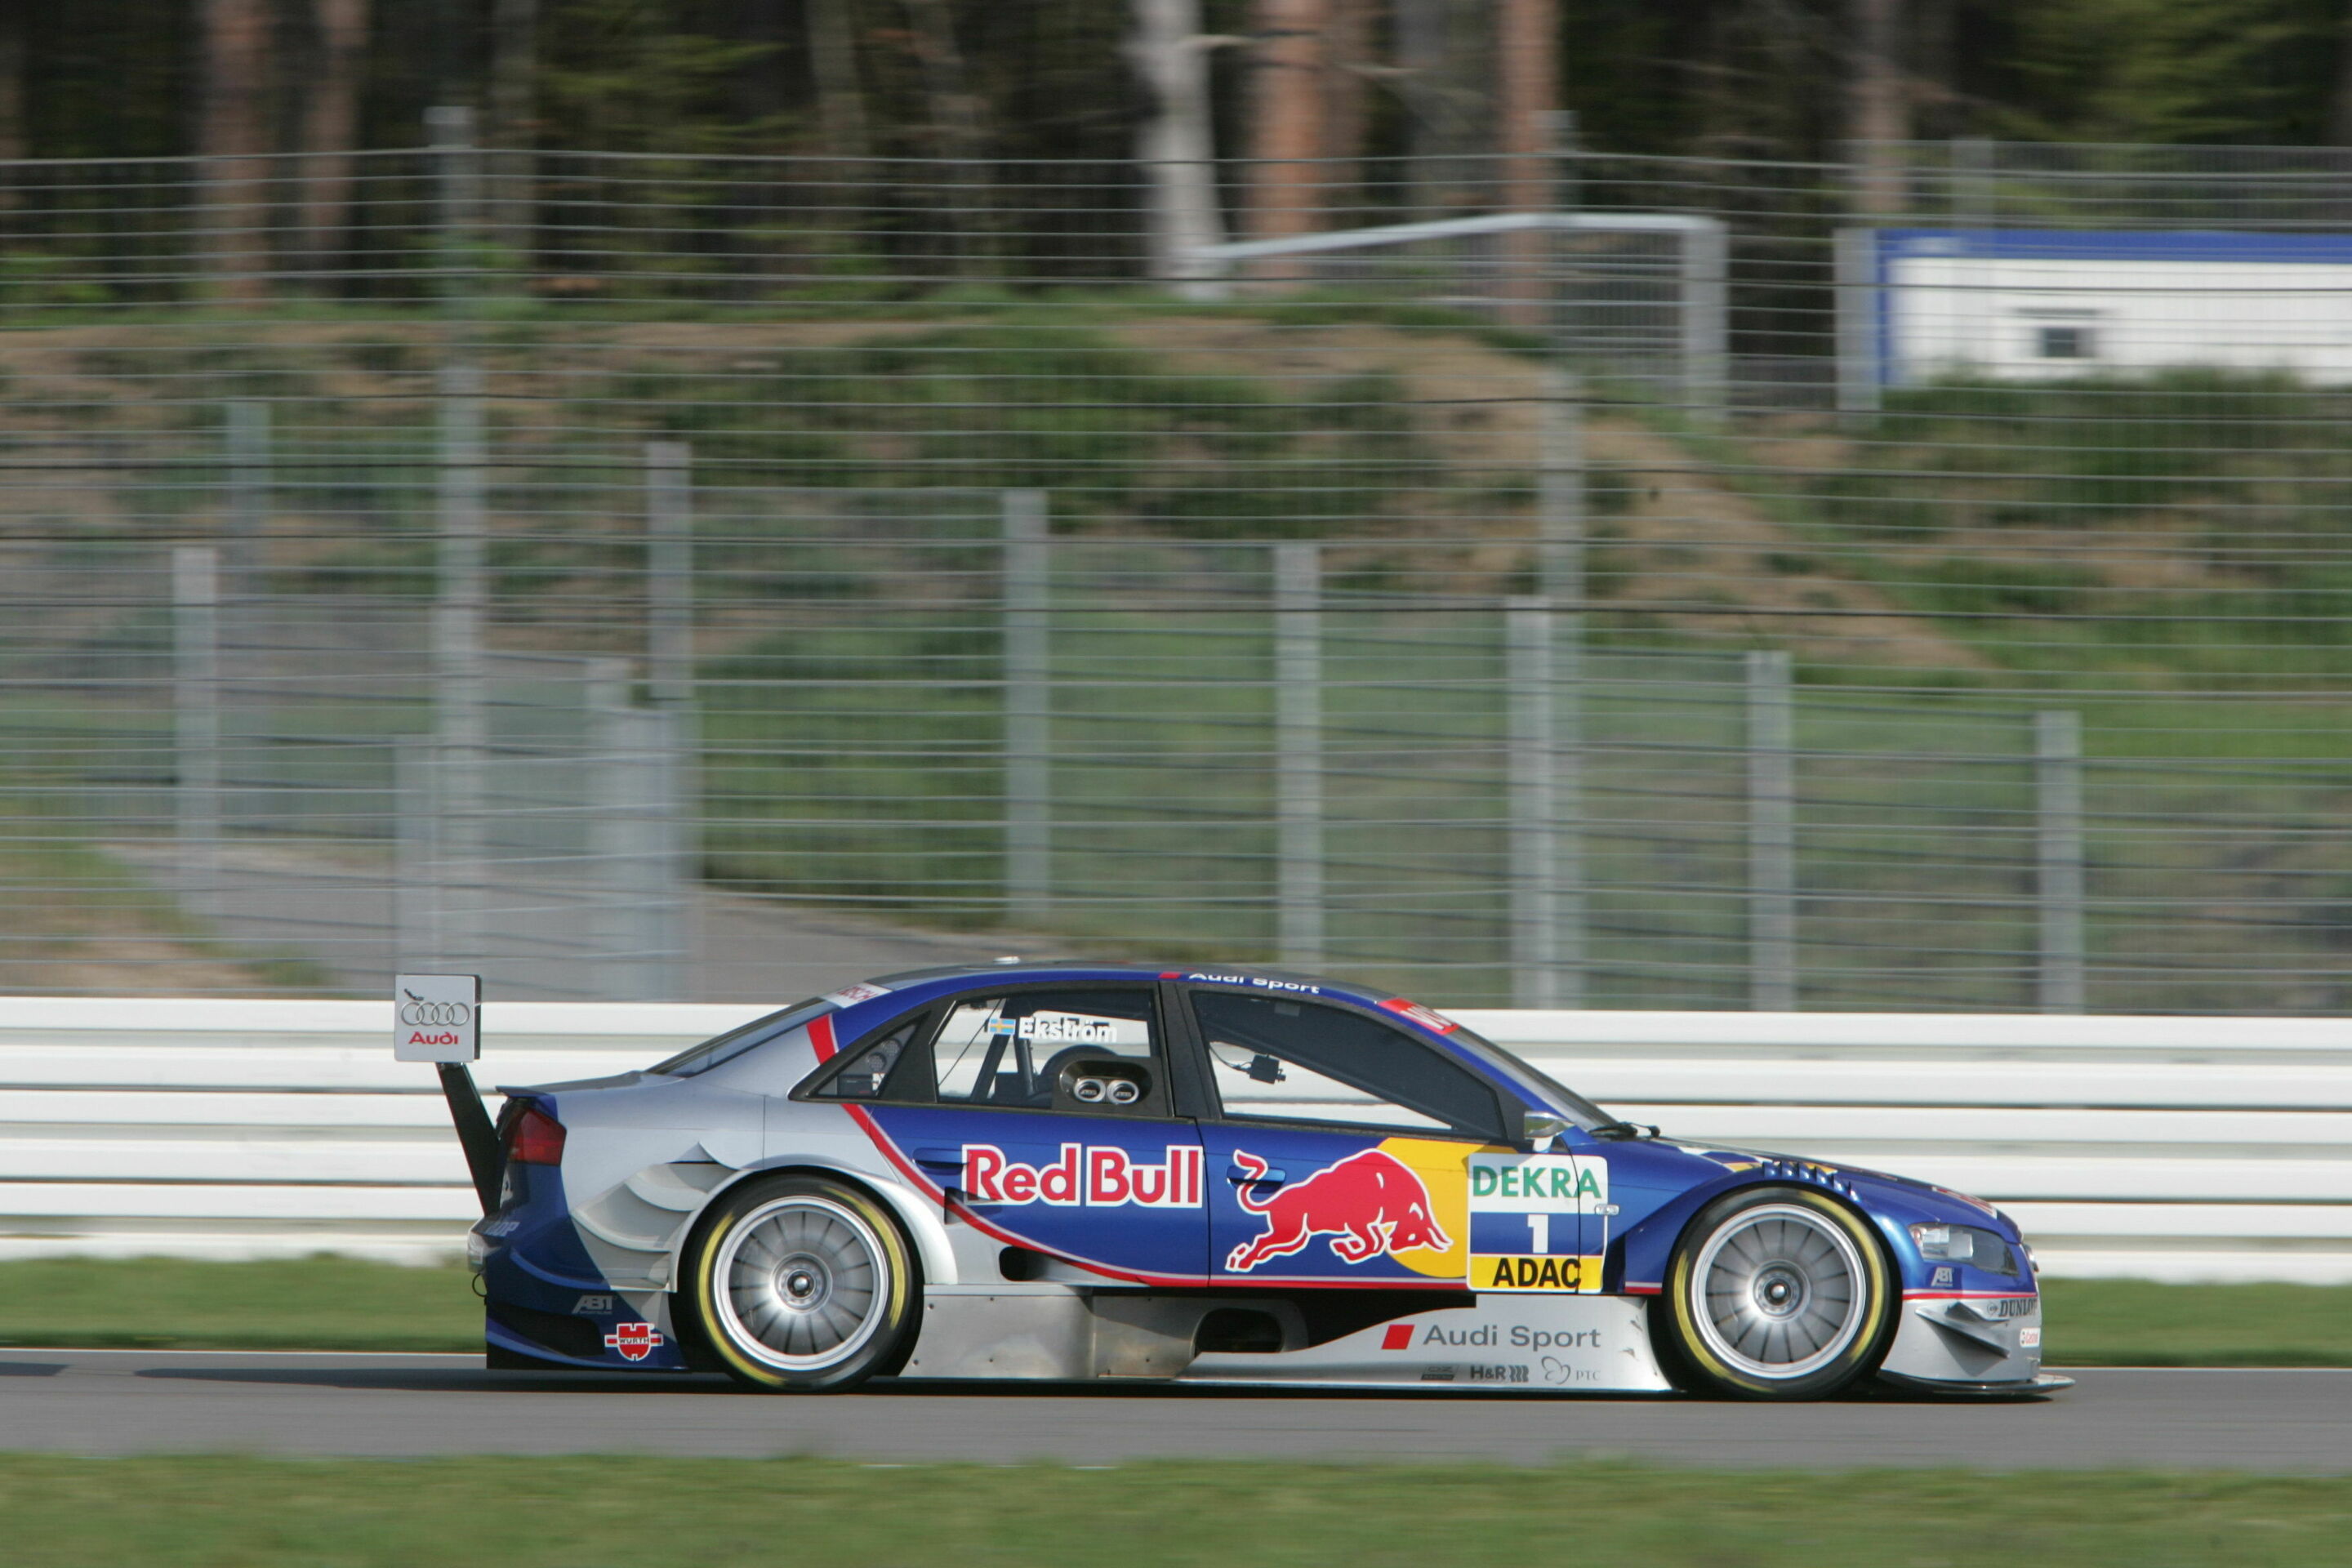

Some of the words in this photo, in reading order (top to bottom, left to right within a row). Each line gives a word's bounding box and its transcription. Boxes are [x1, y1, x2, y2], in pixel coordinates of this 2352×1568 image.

[1189, 973, 1244, 983] Audi
[1253, 978, 1320, 994] Sport
[408, 1031, 458, 1045] Audi
[1018, 1017, 1117, 1043] Ekström
[961, 1143, 1081, 1206] Red
[1086, 1146, 1203, 1208] Bull
[1472, 1165, 1601, 1199] DEKRA
[1527, 1214, 1548, 1254] 1
[1492, 1258, 1581, 1288] ADAC
[572, 1294, 612, 1314] ABT
[1423, 1325, 1497, 1346] Audi
[1511, 1325, 1601, 1351] Sport
[1471, 1365, 1506, 1380] H&R
